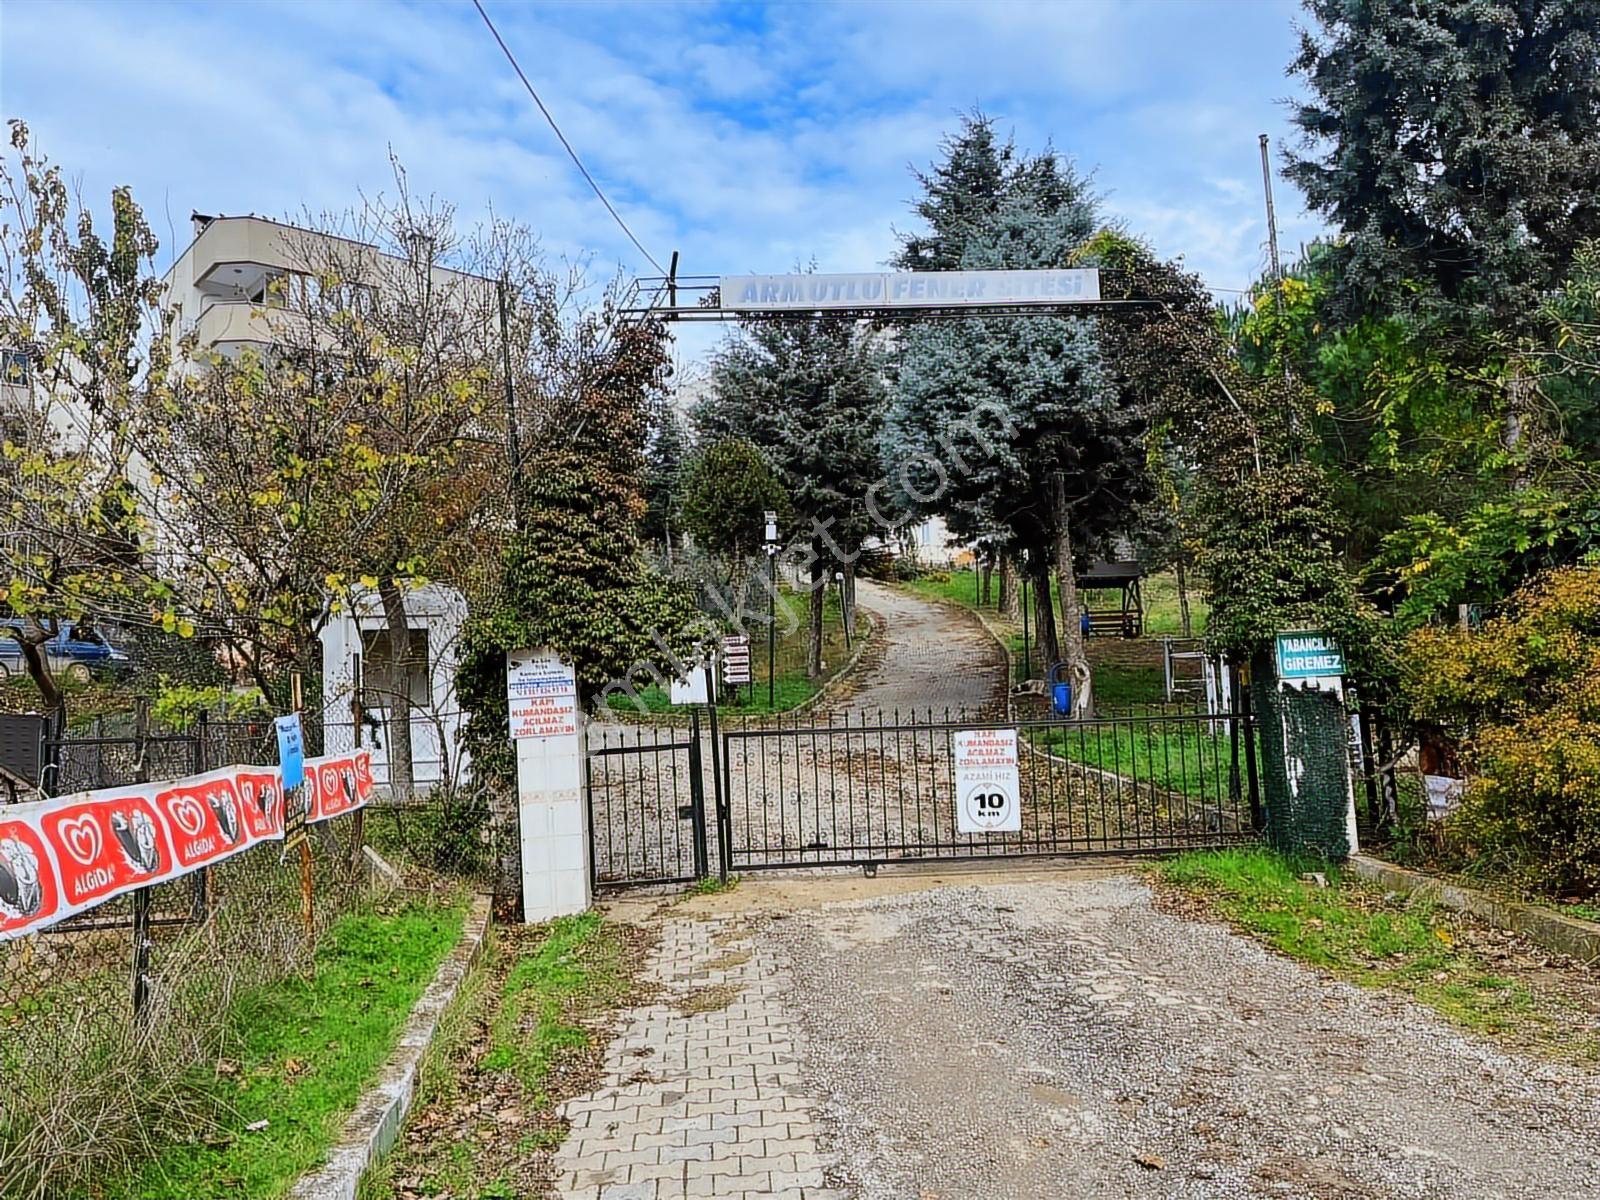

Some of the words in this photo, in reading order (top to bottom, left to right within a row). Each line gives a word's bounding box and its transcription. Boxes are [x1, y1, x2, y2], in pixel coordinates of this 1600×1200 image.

[741, 278, 882, 304] ARMUTLU
[530, 697, 555, 706] KAPI
[511, 706, 574, 718] KUMANDASIZ
[513, 726, 574, 736] ZORLAMAYIN
[973, 793, 1005, 809] 10
